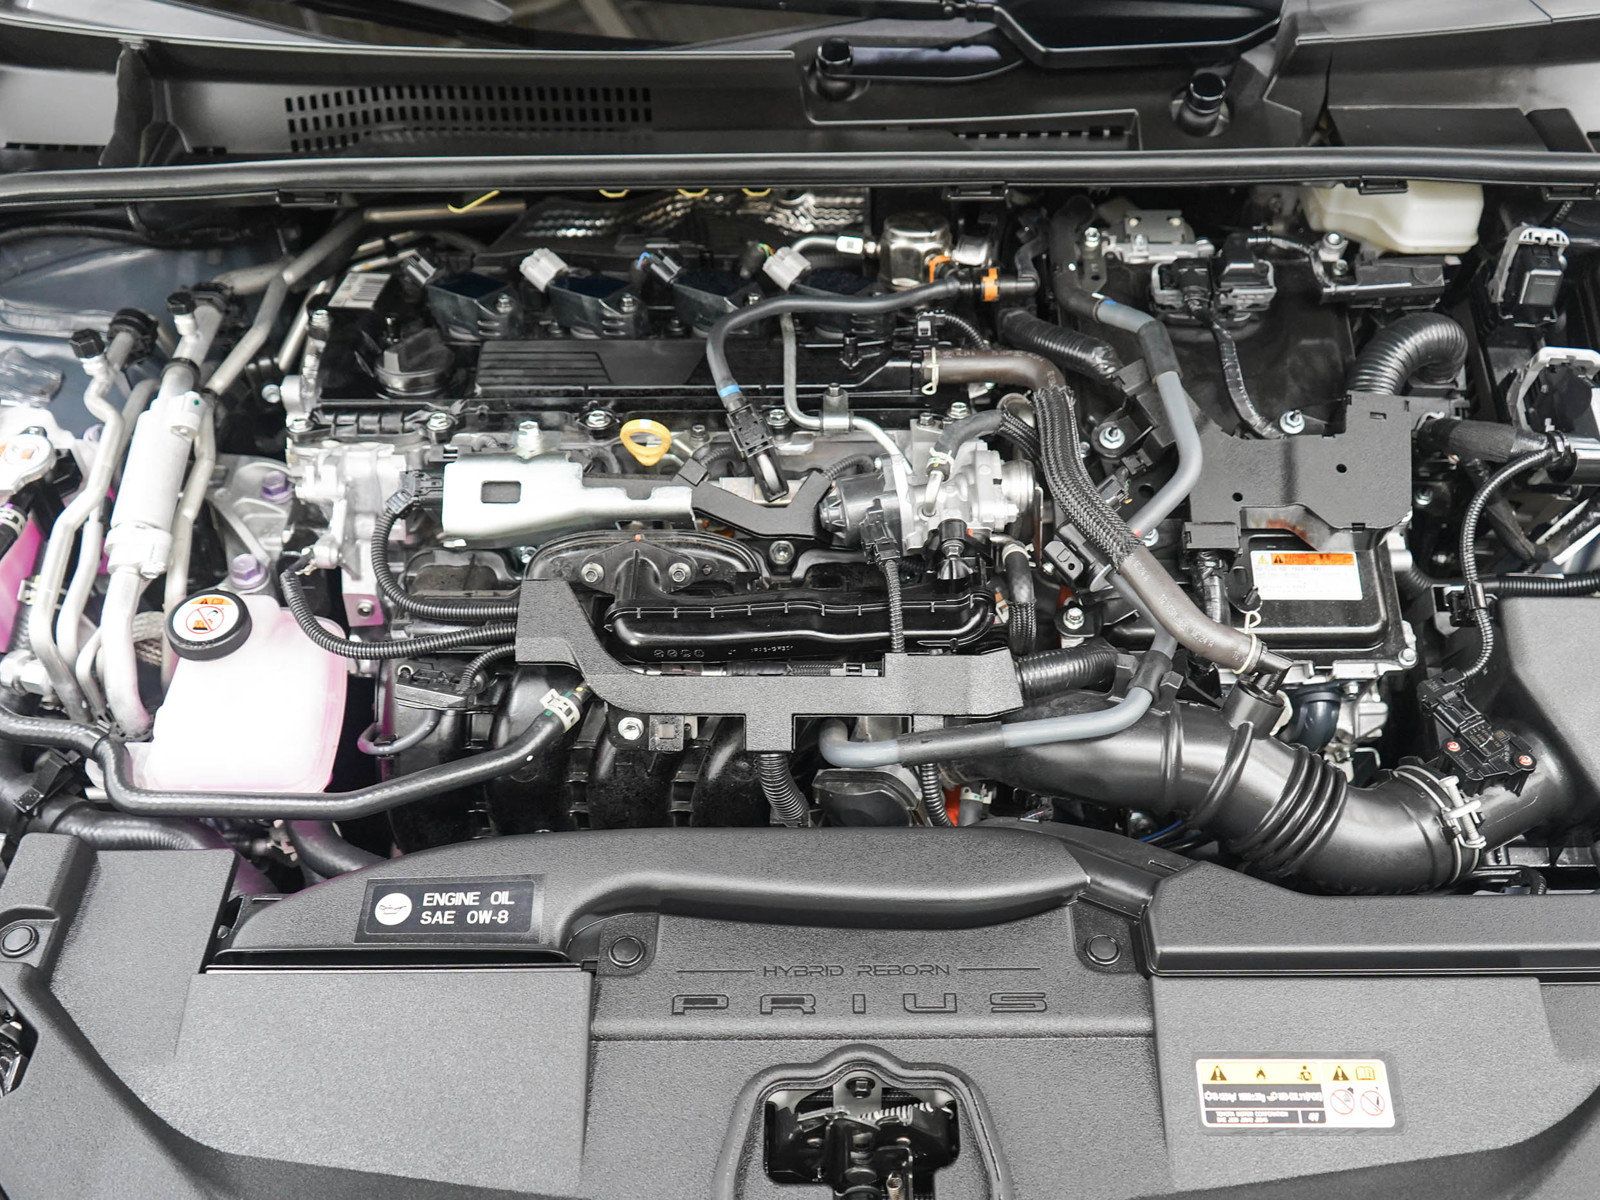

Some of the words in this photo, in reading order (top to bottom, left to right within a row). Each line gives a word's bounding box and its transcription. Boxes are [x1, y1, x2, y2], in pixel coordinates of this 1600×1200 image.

[422, 891, 481, 907] ENGINE
[490, 890, 515, 906] OIL
[420, 910, 456, 925] SAE
[466, 909, 509, 925] 0W-8
[763, 964, 845, 978] HYBRID
[857, 963, 951, 977] REBORN
[671, 991, 1048, 1016] PRIUS
